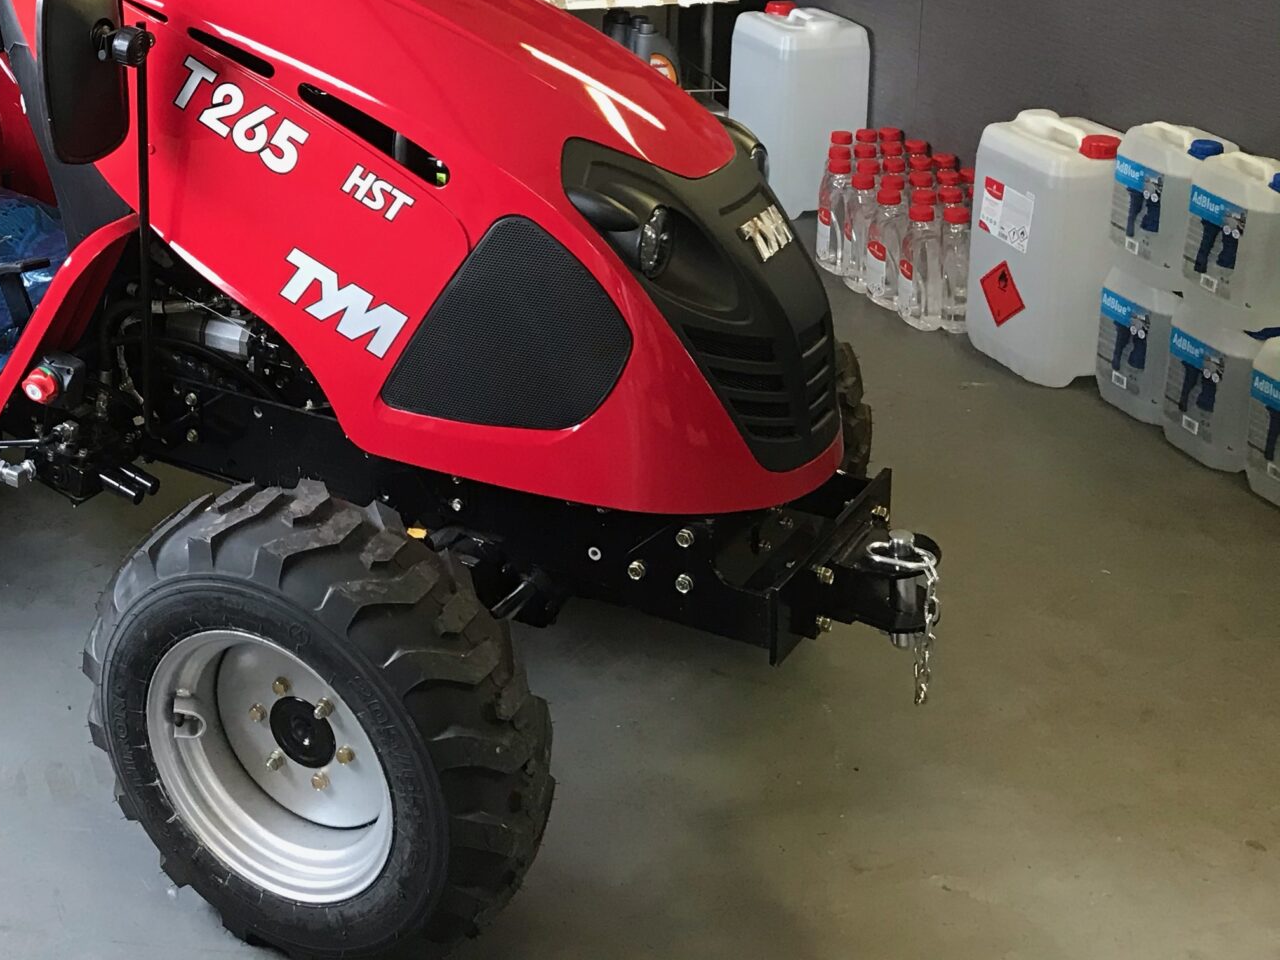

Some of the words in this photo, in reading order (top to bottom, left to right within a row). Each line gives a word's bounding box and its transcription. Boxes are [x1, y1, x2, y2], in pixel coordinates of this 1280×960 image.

[342, 164, 415, 223] HST
[1192, 191, 1220, 214] AdBlue
[279, 246, 411, 359] TYM
[1102, 293, 1127, 315] AdBlue
[1173, 333, 1200, 358] AdBlue
